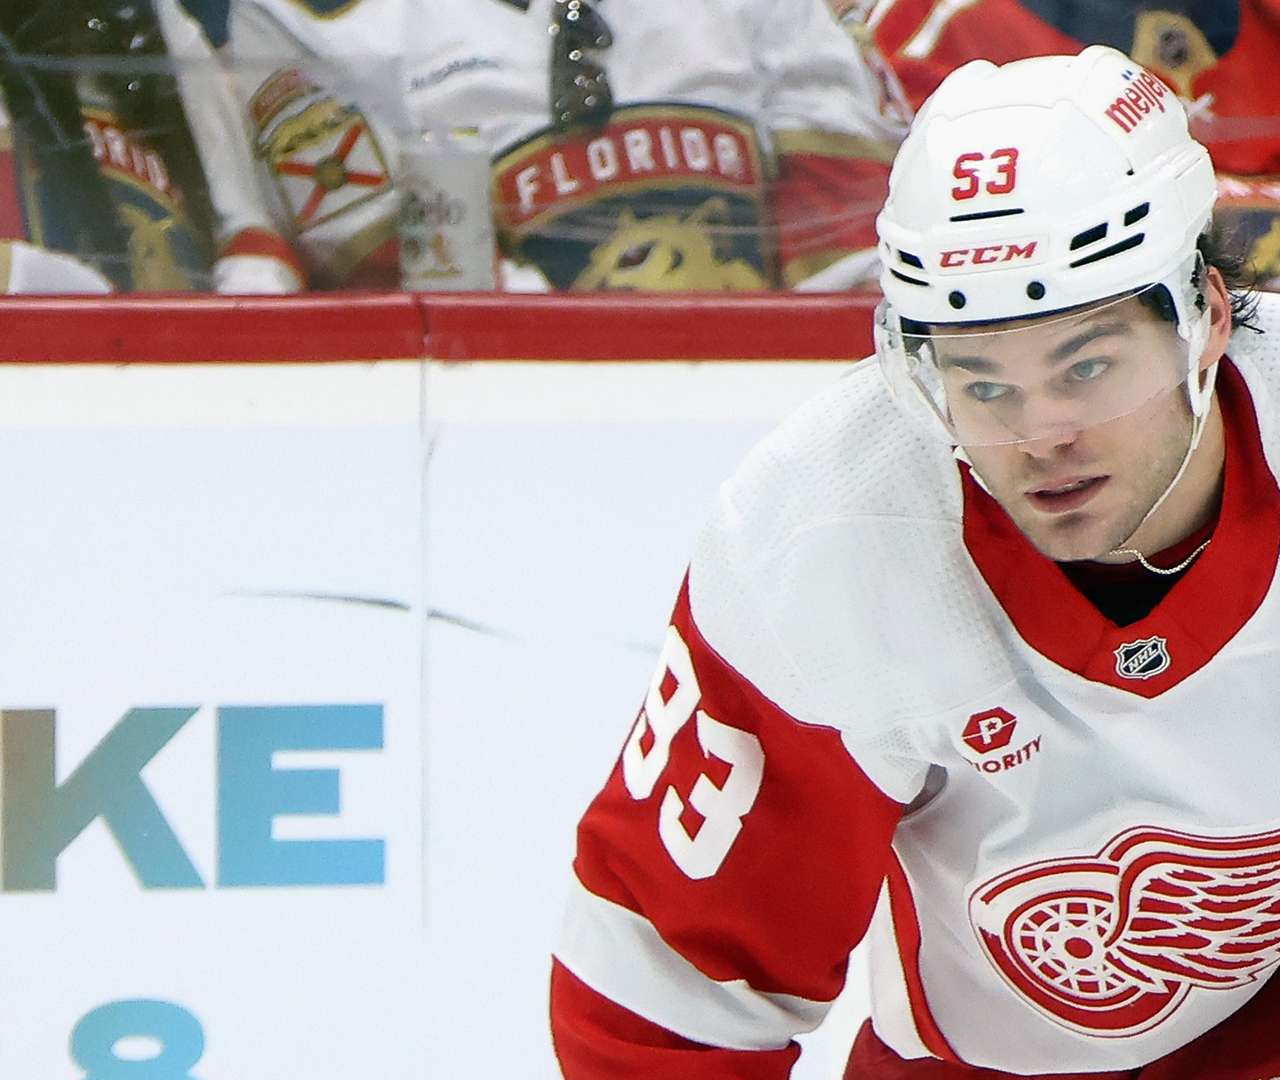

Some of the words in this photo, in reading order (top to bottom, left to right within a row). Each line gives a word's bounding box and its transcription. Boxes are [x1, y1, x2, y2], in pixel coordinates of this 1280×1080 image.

[516, 126, 743, 214] FLORIDA
[951, 147, 1019, 201] 53
[939, 241, 1038, 268] CCM
[1127, 642, 1159, 674] NHL
[622, 624, 766, 880] 93
[974, 735, 1042, 773] IORITY
